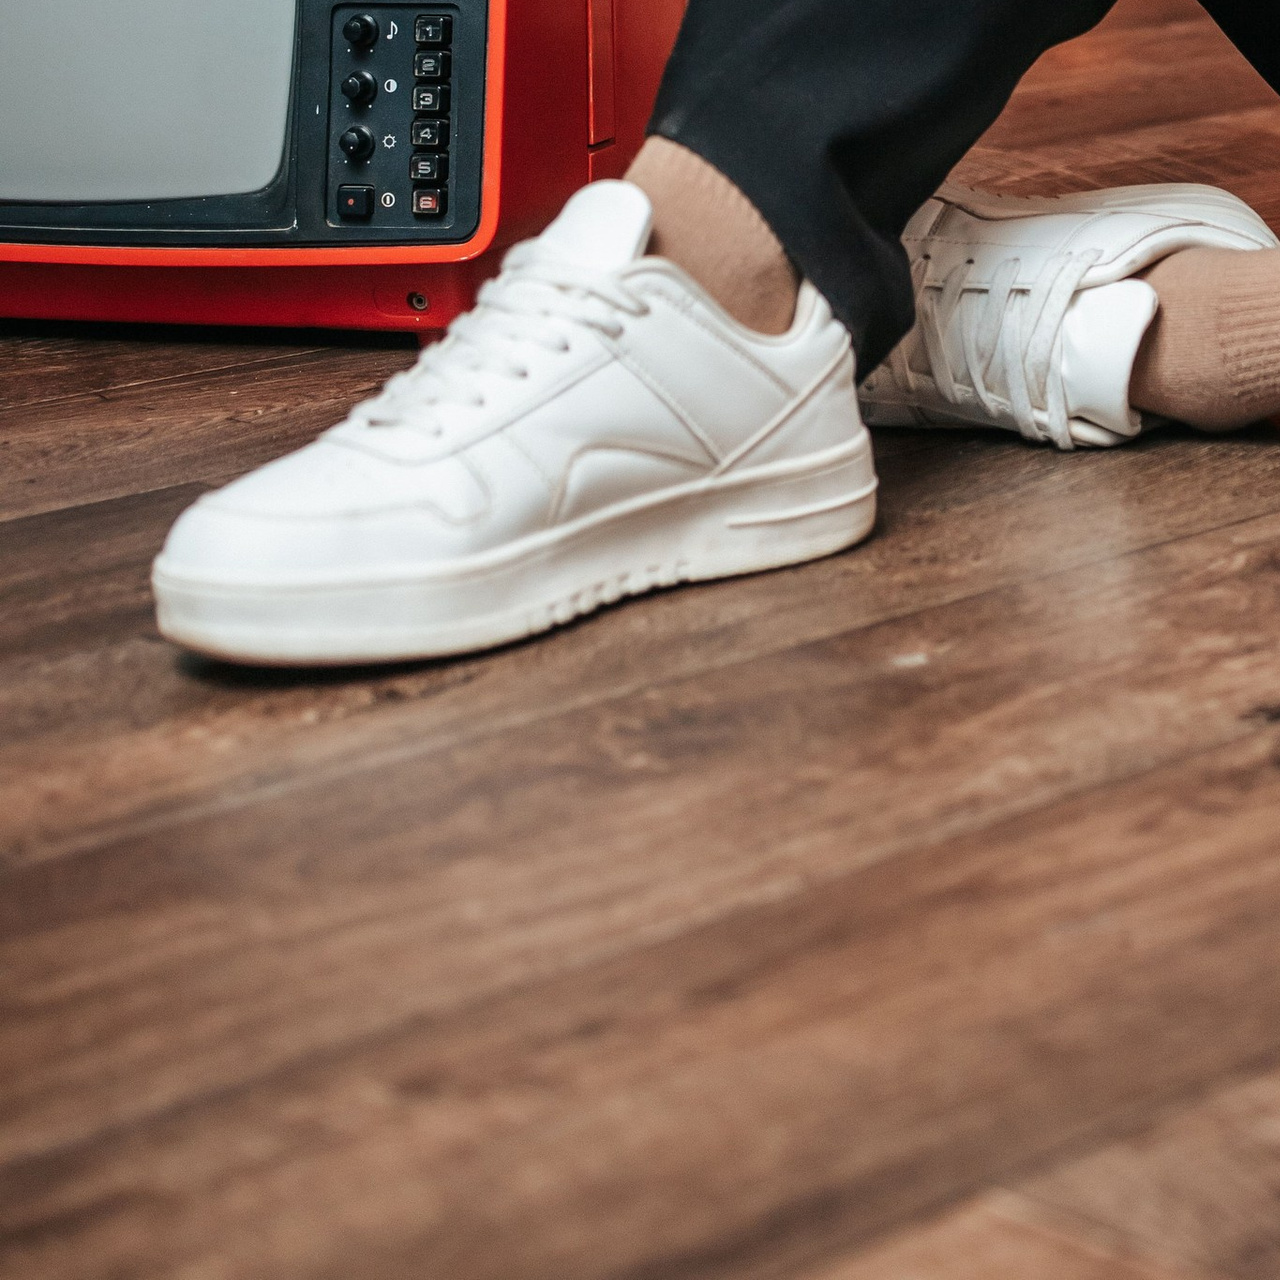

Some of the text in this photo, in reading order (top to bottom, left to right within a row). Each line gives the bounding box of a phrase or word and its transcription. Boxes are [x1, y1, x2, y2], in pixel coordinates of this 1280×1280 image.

[422, 58, 435, 72] 2
[420, 93, 433, 106] 3
[419, 127, 432, 140] 4
[418, 160, 431, 174] 5
[419, 196, 434, 209] 6
